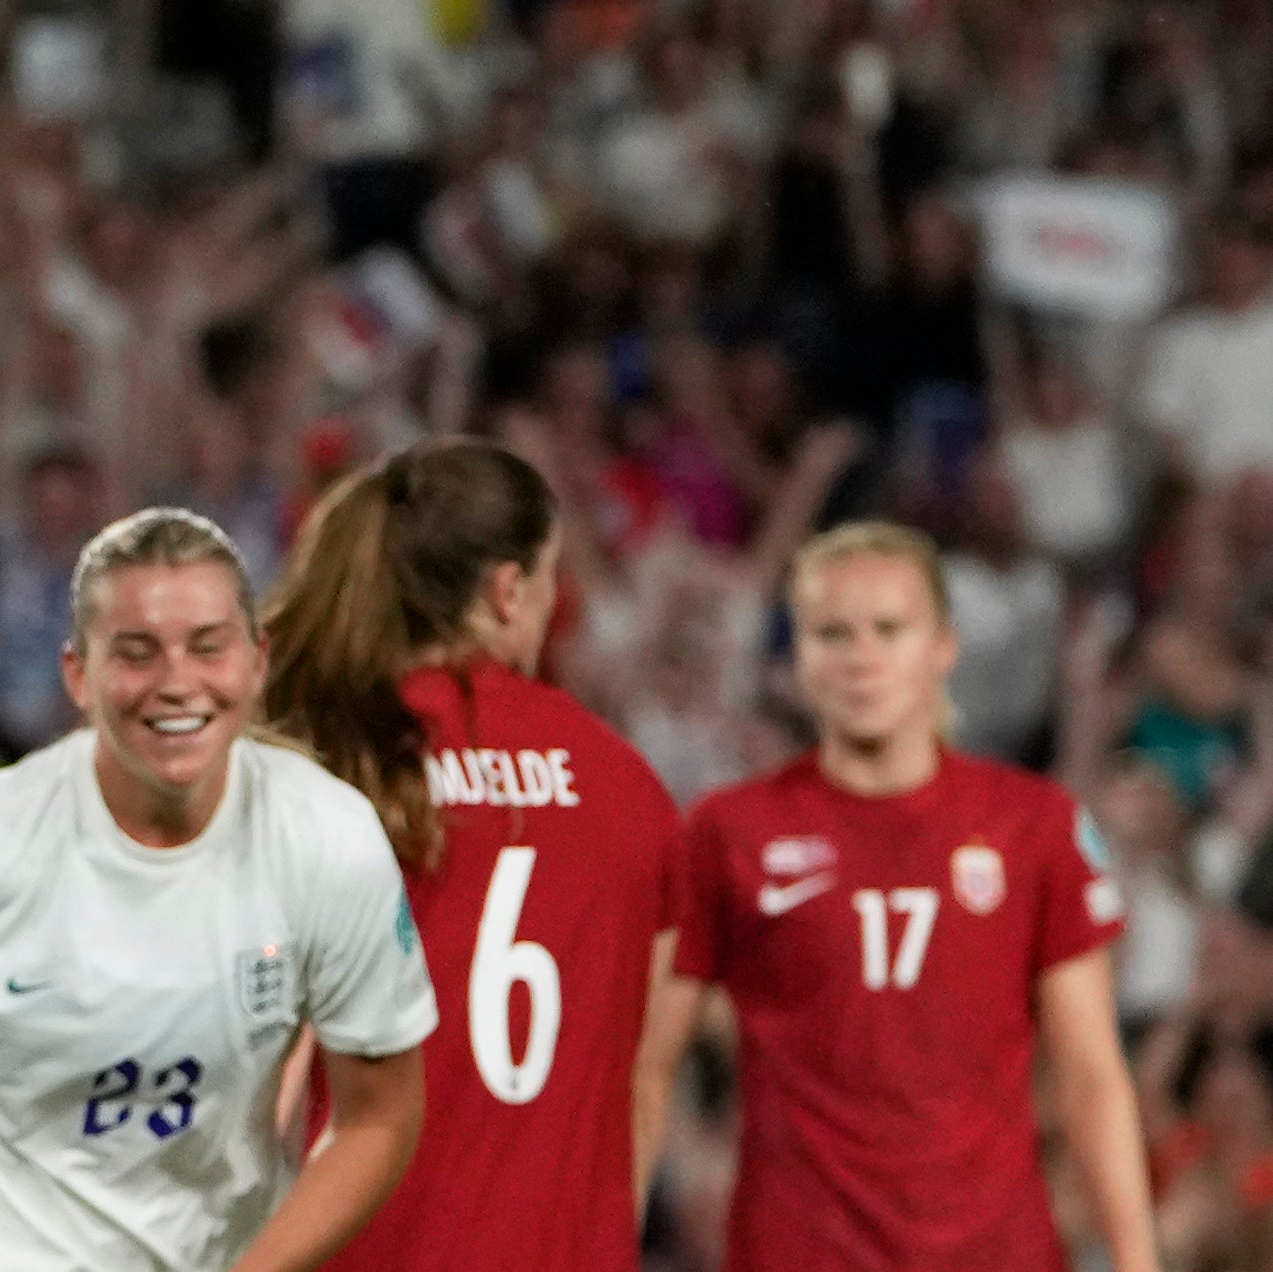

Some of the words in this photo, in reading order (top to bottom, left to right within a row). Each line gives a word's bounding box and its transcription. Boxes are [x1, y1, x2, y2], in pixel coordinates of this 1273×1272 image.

[468, 846, 562, 1106] 6
[851, 887, 940, 991] 17
[83, 1056, 203, 1138] 23
